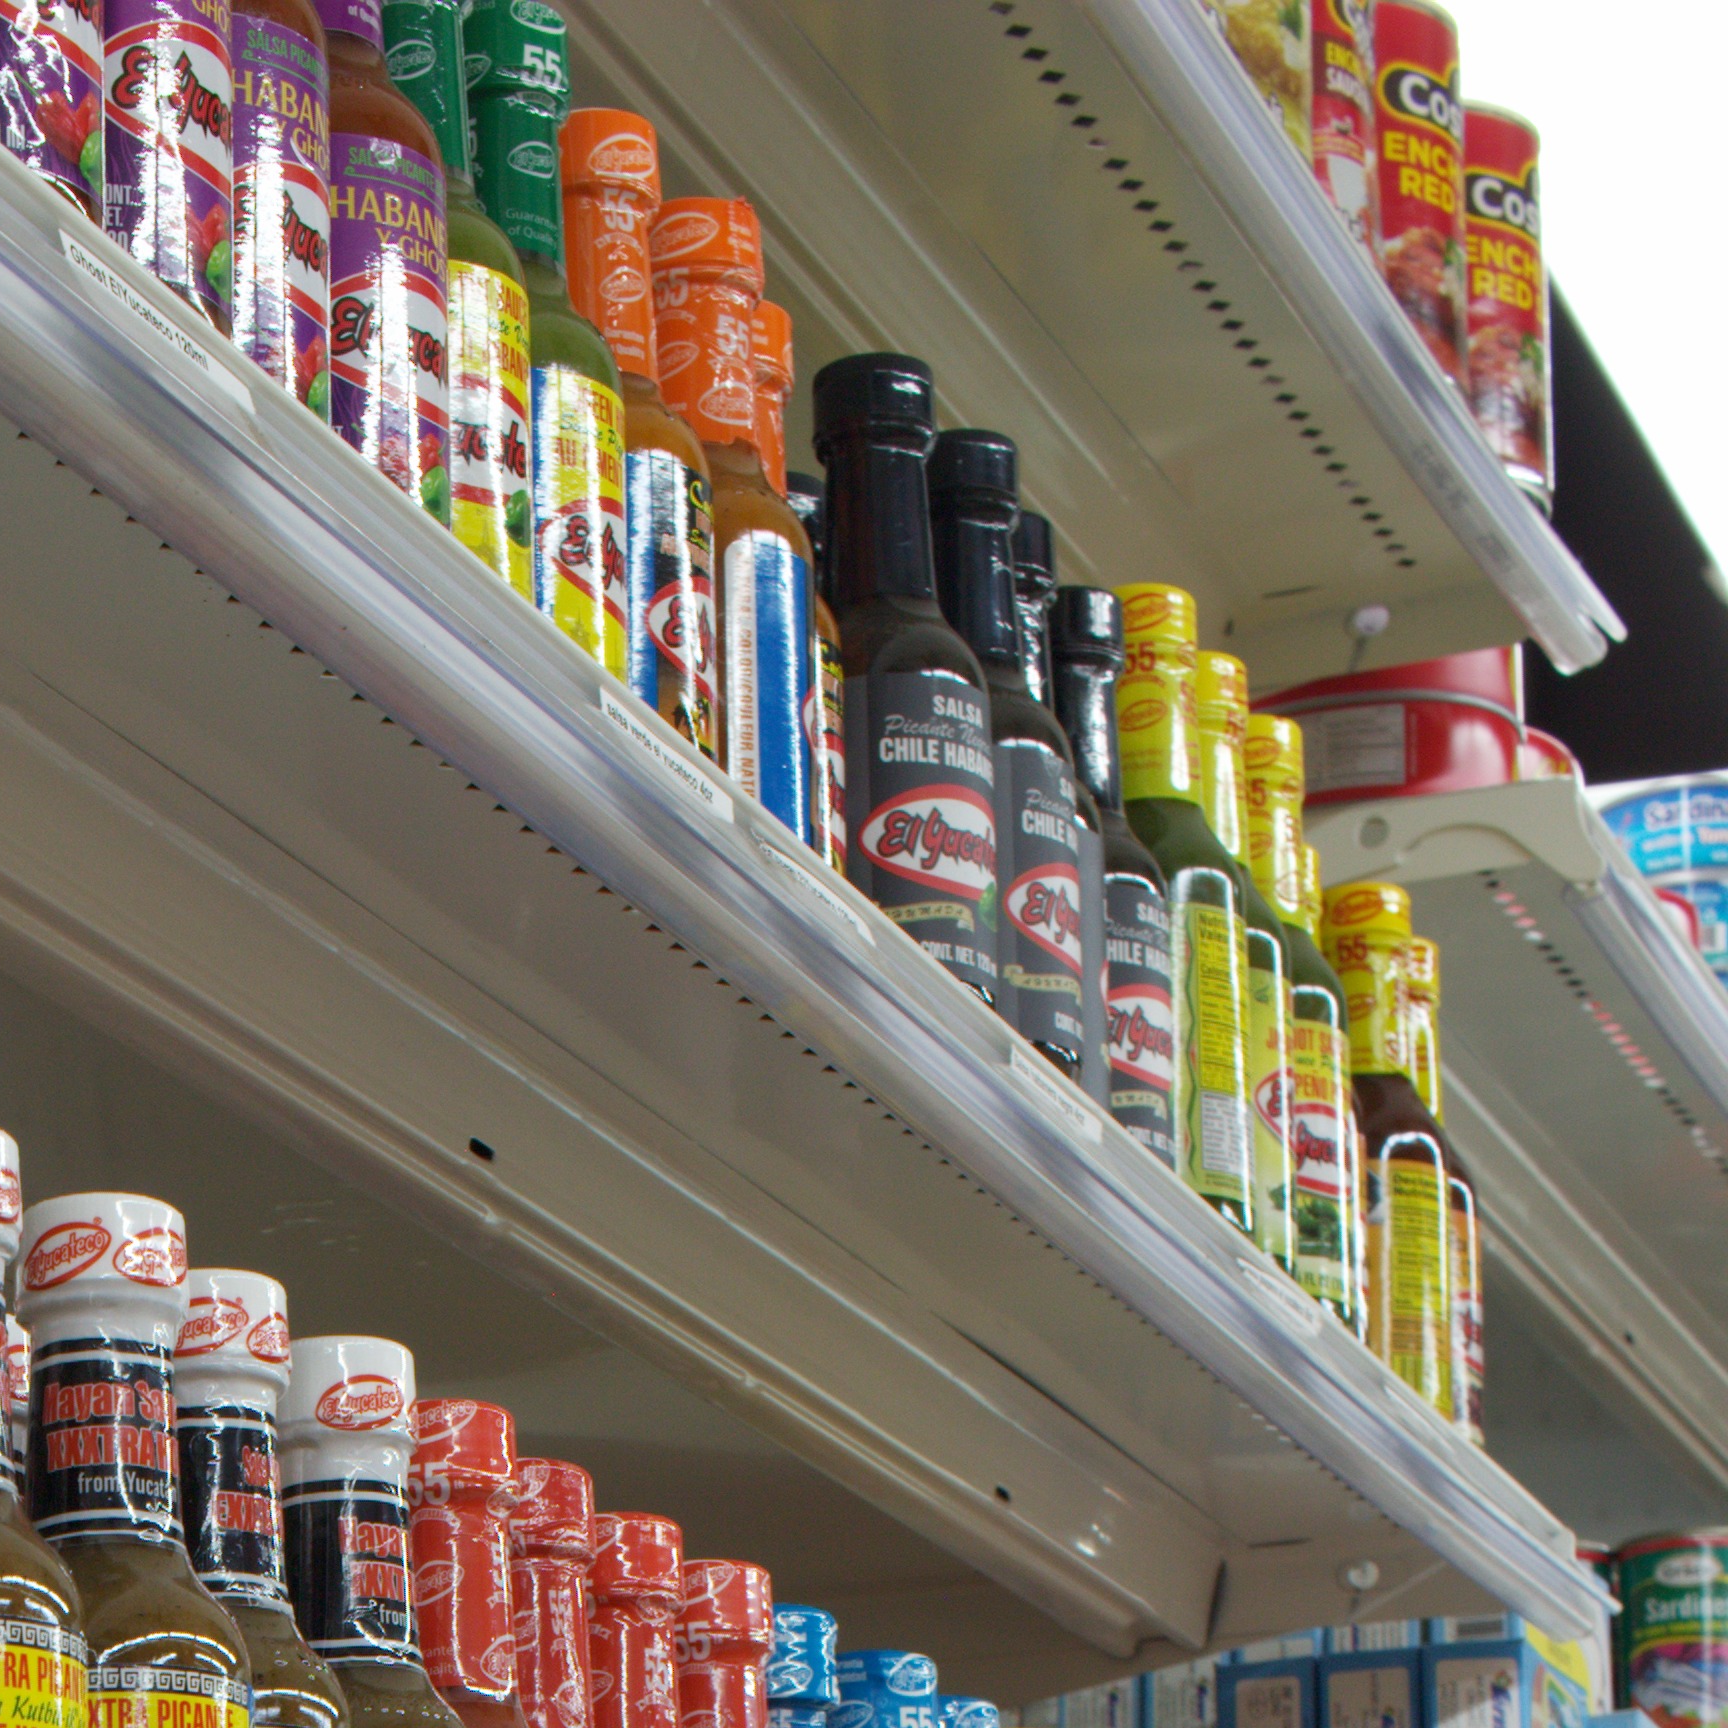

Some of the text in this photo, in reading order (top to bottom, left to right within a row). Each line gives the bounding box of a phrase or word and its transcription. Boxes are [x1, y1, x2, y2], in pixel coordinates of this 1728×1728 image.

[1398, 165, 1458, 208] RED
[931, 694, 982, 729] SALSA
[878, 736, 939, 765] CHILE
